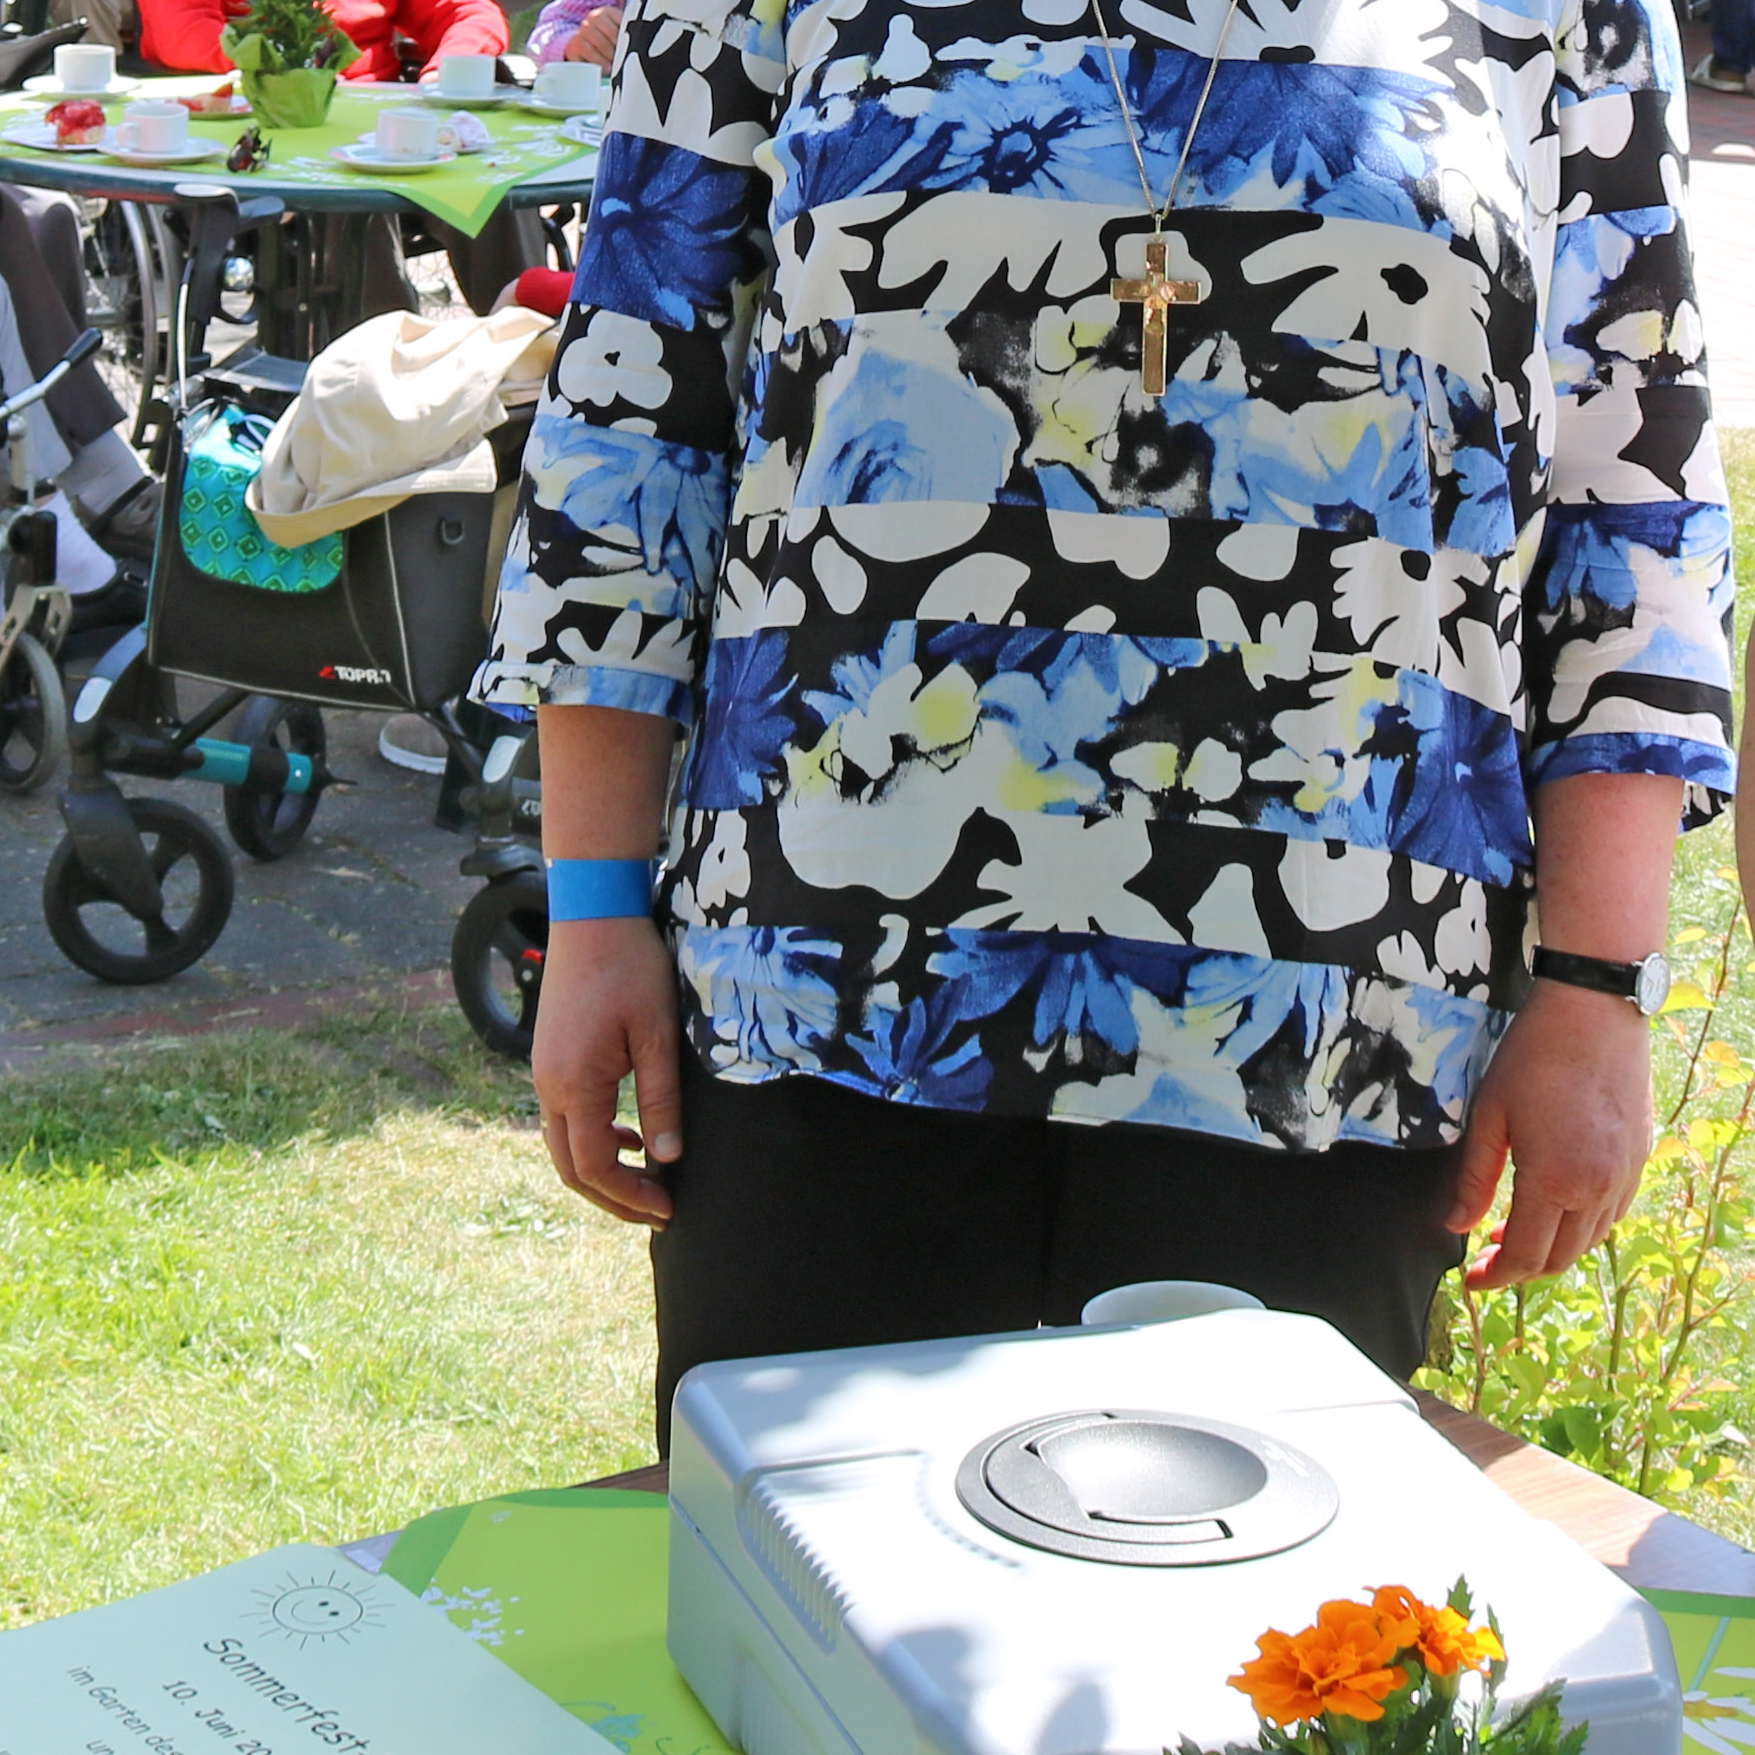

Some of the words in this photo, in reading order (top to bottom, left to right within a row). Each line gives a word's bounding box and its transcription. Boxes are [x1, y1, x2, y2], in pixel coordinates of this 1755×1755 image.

[66, 1664, 95, 1686] im
[88, 1686, 151, 1736] Garten
[162, 1680, 198, 1706] 10.
[194, 1707, 246, 1739] Juni
[203, 1637, 371, 1754] Sommerfest
